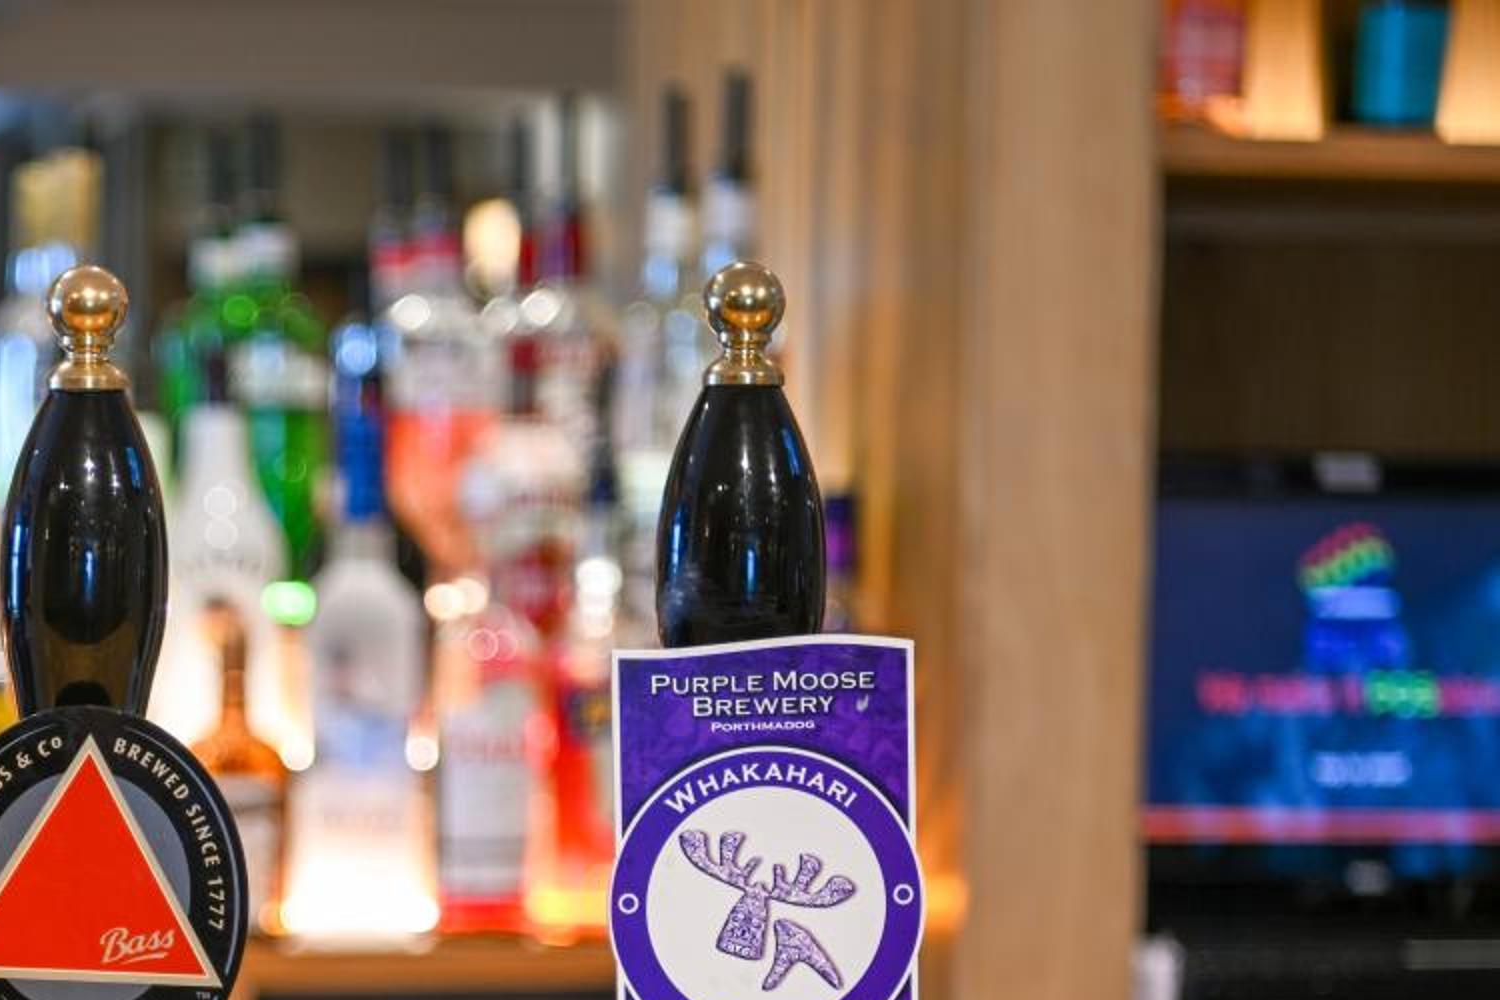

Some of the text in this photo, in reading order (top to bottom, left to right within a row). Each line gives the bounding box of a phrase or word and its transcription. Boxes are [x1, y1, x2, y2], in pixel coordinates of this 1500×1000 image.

[651, 671, 875, 695] PURPLE MOOSE
[693, 695, 834, 717] BREWERY
[711, 720, 815, 733] PORTHMADOG
[16, 752, 34, 769] &
[664, 763, 858, 814] WHAKAHARI
[113, 737, 225, 931] BREWED SINCE 1777
[100, 927, 175, 964] Bass
